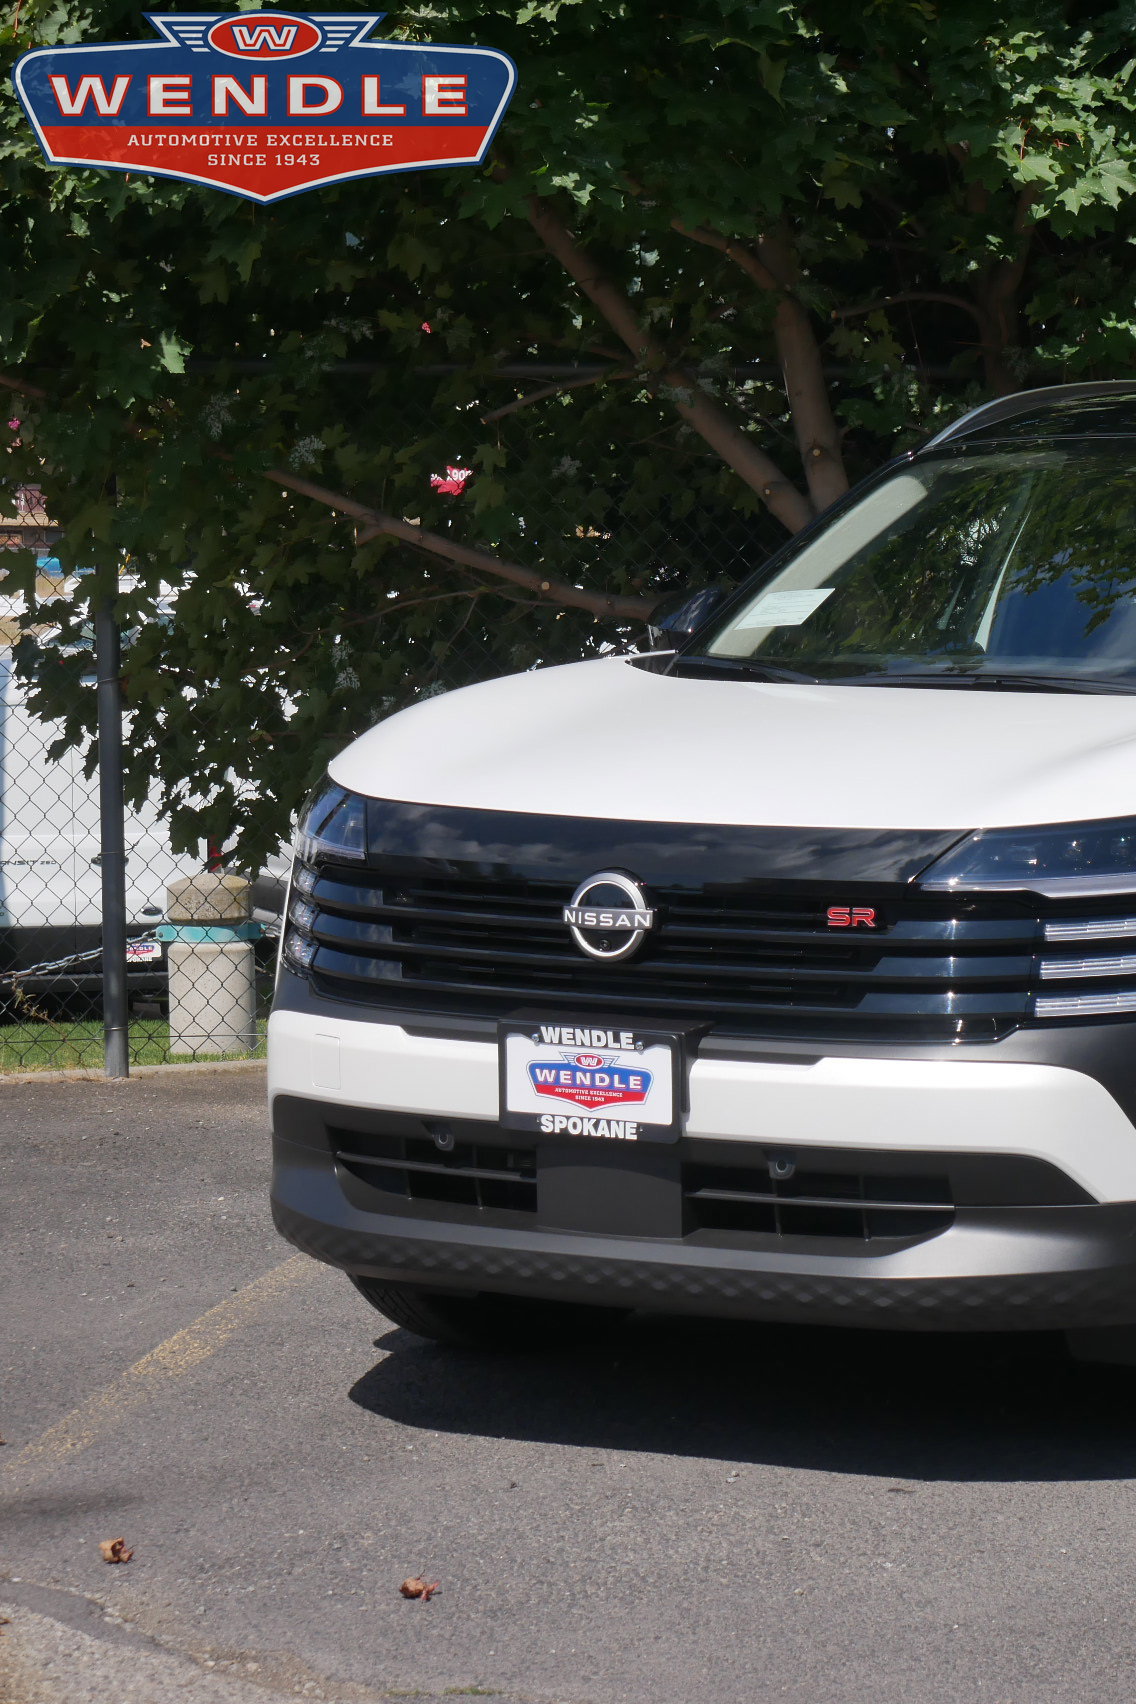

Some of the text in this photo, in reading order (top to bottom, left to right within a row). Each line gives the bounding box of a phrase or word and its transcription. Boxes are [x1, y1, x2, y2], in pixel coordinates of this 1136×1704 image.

[564, 909, 650, 928] NISSAN
[827, 907, 876, 927] SR
[540, 1026, 635, 1050] WENDLE
[535, 1068, 643, 1090] WENDLE
[540, 1115, 638, 1140] SPOKANE
